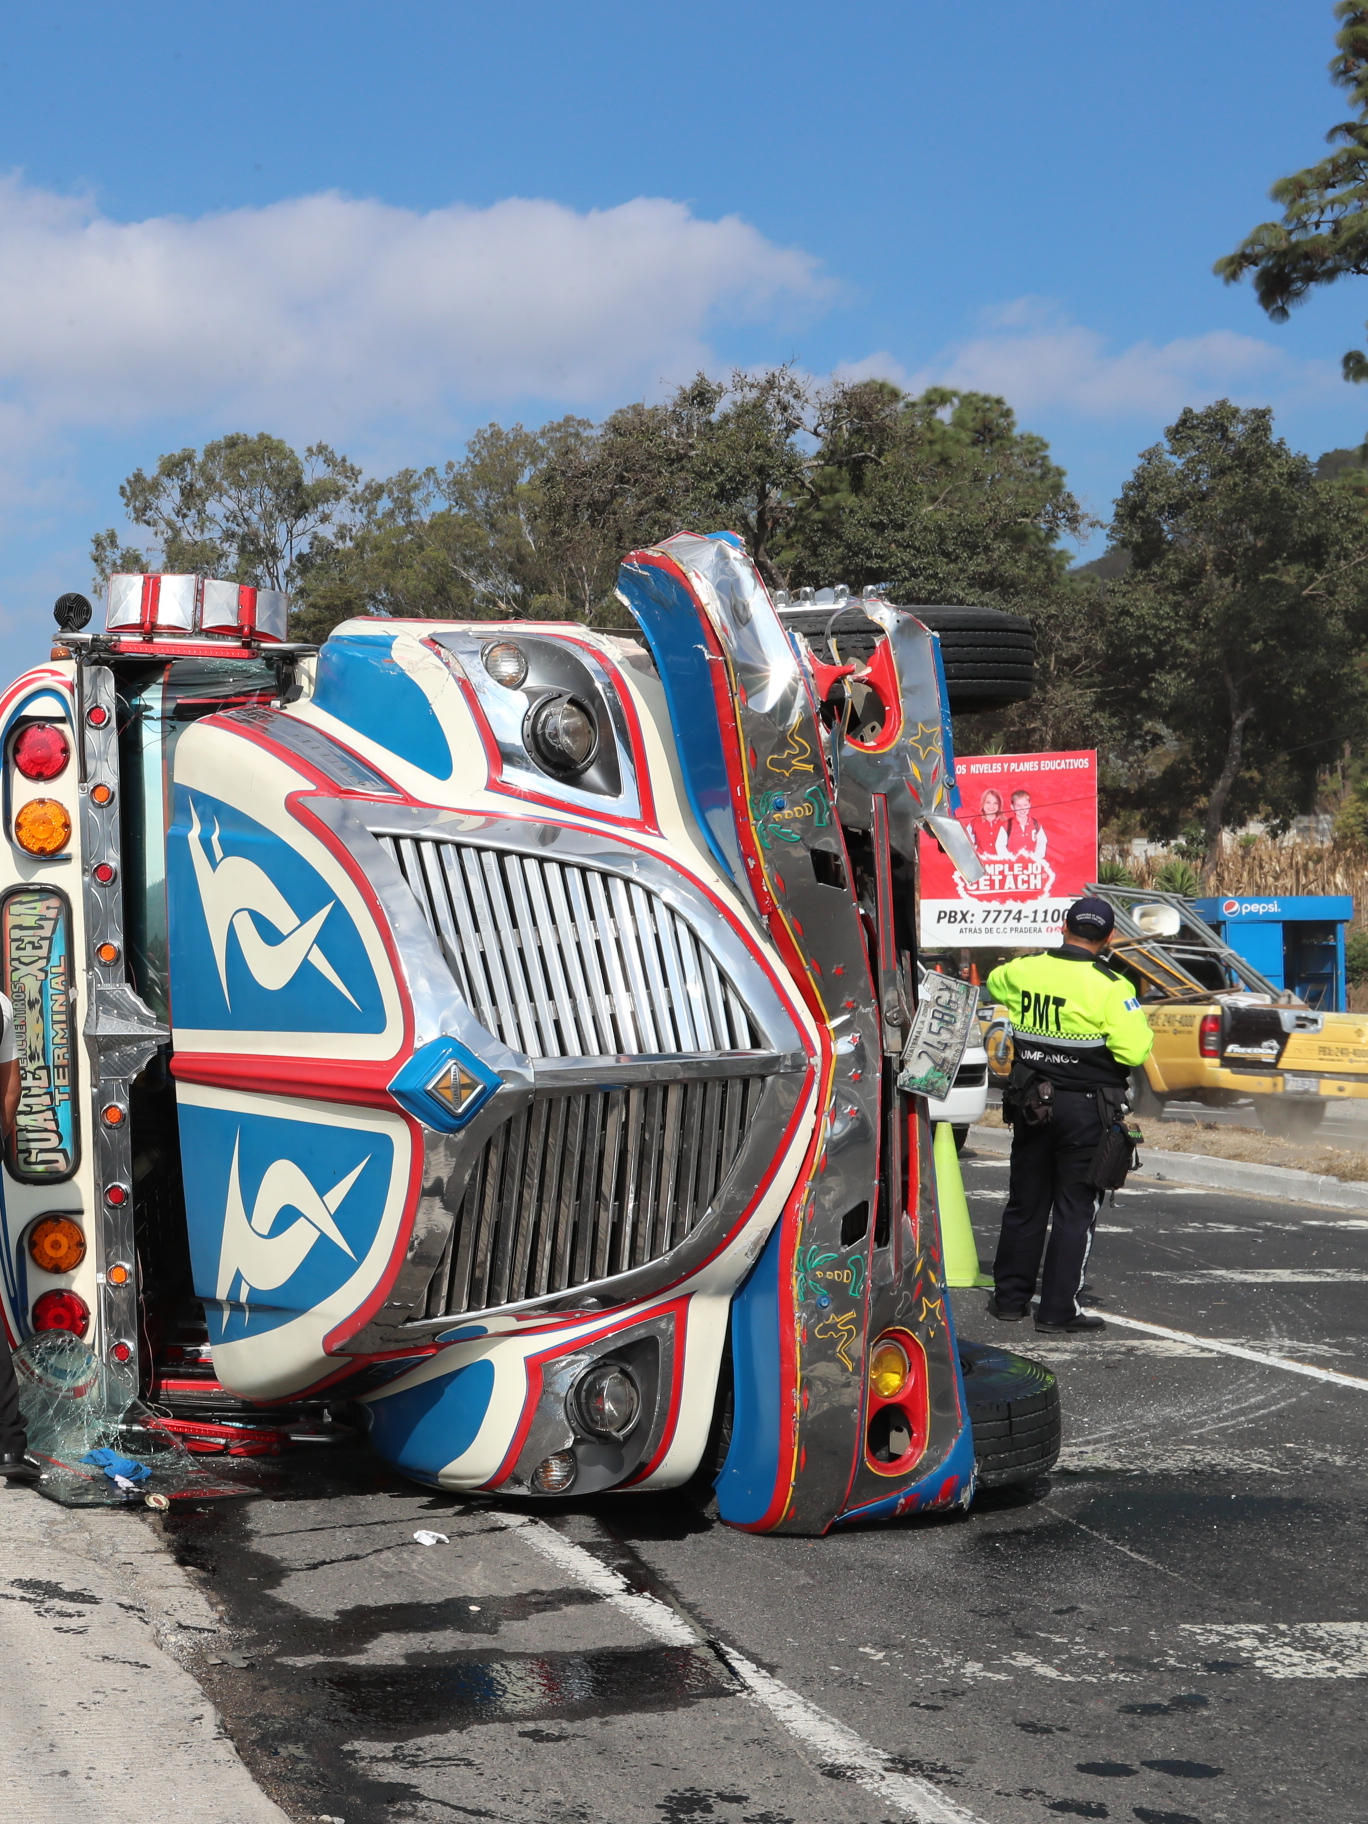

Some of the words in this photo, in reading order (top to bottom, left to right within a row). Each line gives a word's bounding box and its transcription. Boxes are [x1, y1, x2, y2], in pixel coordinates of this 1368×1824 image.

[955, 764, 967, 775] OS
[970, 763, 1001, 774] NIVELES
[1003, 763, 1009, 773] Y
[1010, 761, 1039, 772] PLANES
[1041, 758, 1089, 770] EDUCATIVOS
[936, 910, 975, 924] PBX:
[959, 926, 982, 935] ATRÁS
[985, 926, 994, 934] DE
[1010, 926, 1043, 934] PRADERA
[9, 896, 62, 982] XELA
[1020, 989, 1066, 1031] PMT
[50, 954, 70, 1107] TERMINAL
